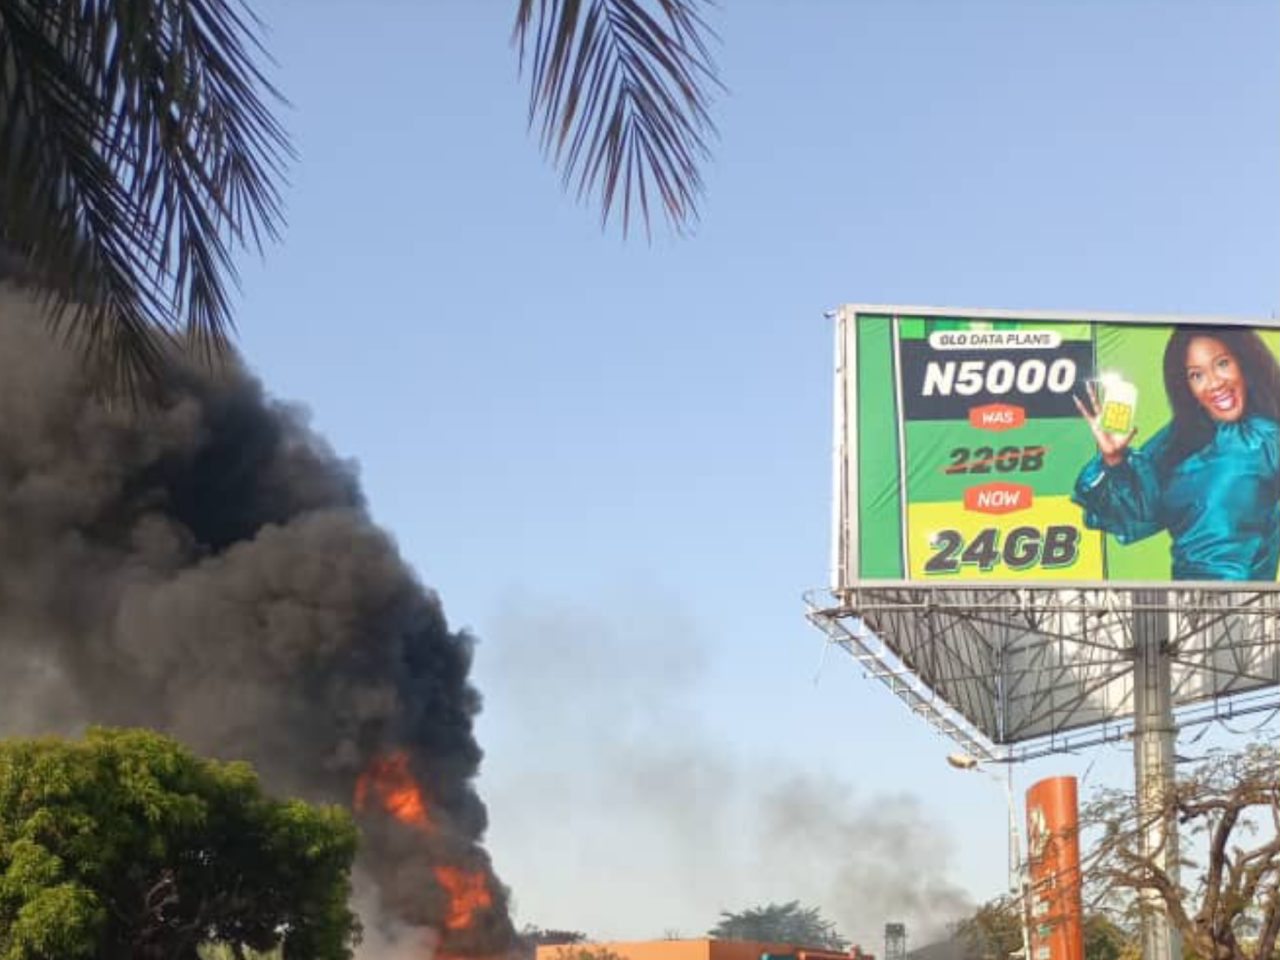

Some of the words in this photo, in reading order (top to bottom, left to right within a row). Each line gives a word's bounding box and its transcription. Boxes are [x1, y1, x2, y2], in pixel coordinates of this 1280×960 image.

[968, 333, 1002, 346] DATA
[1005, 334, 1051, 346] PLANS
[922, 358, 1077, 397] N5000
[981, 410, 1014, 425] WAS
[945, 445, 1045, 475] 22GB
[977, 490, 1019, 507] NOW
[923, 525, 1080, 573] 24GB
